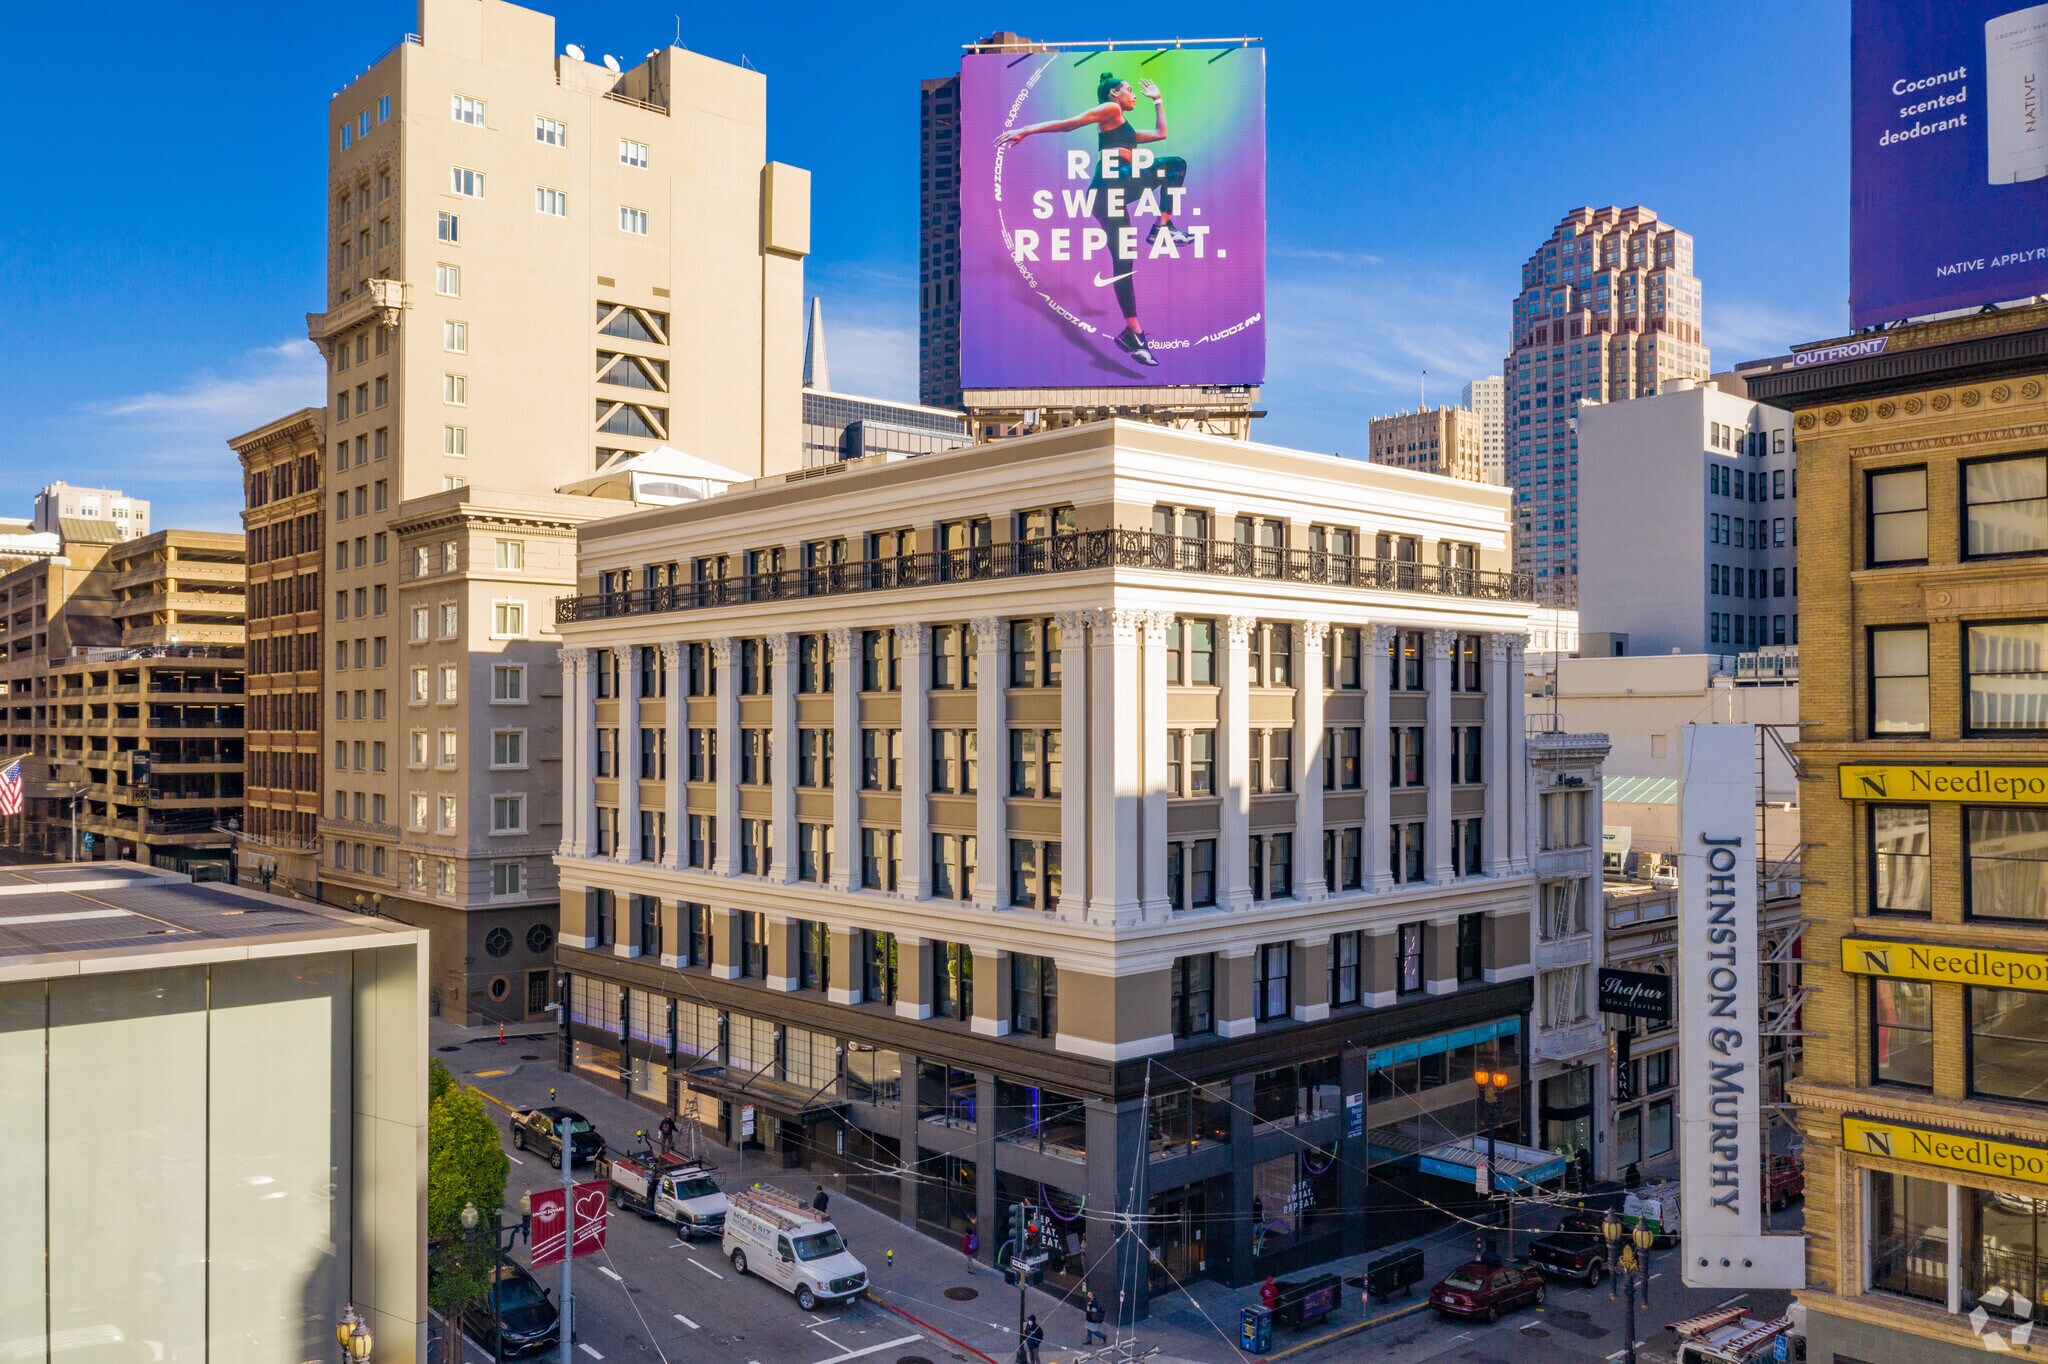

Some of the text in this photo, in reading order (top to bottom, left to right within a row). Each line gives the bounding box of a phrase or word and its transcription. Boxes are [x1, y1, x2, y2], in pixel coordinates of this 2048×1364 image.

[1892, 66, 1967, 97] Coconut
[1899, 87, 1967, 119] scented
[2024, 73, 2036, 133] NATIVE
[1879, 113, 1967, 147] deodorant
[1067, 149, 1165, 179] REP.
[1032, 187, 1202, 220] SWEAT.
[1014, 226, 1227, 262] REPEAT.
[1937, 258, 1985, 278] NATIVE
[1990, 249, 2035, 268] APPLY
[1795, 340, 1885, 366] OUTFRONT
[1909, 770, 2048, 800] Needlepo
[1651, 929, 1673, 945] ZARA
[1601, 977, 1666, 1002] Shapur
[1700, 832, 1745, 1216] JOHNSTON & MURPHY
[1618, 1060, 1629, 1099] ZARA
[1911, 1131, 2048, 1176] Needlepo
